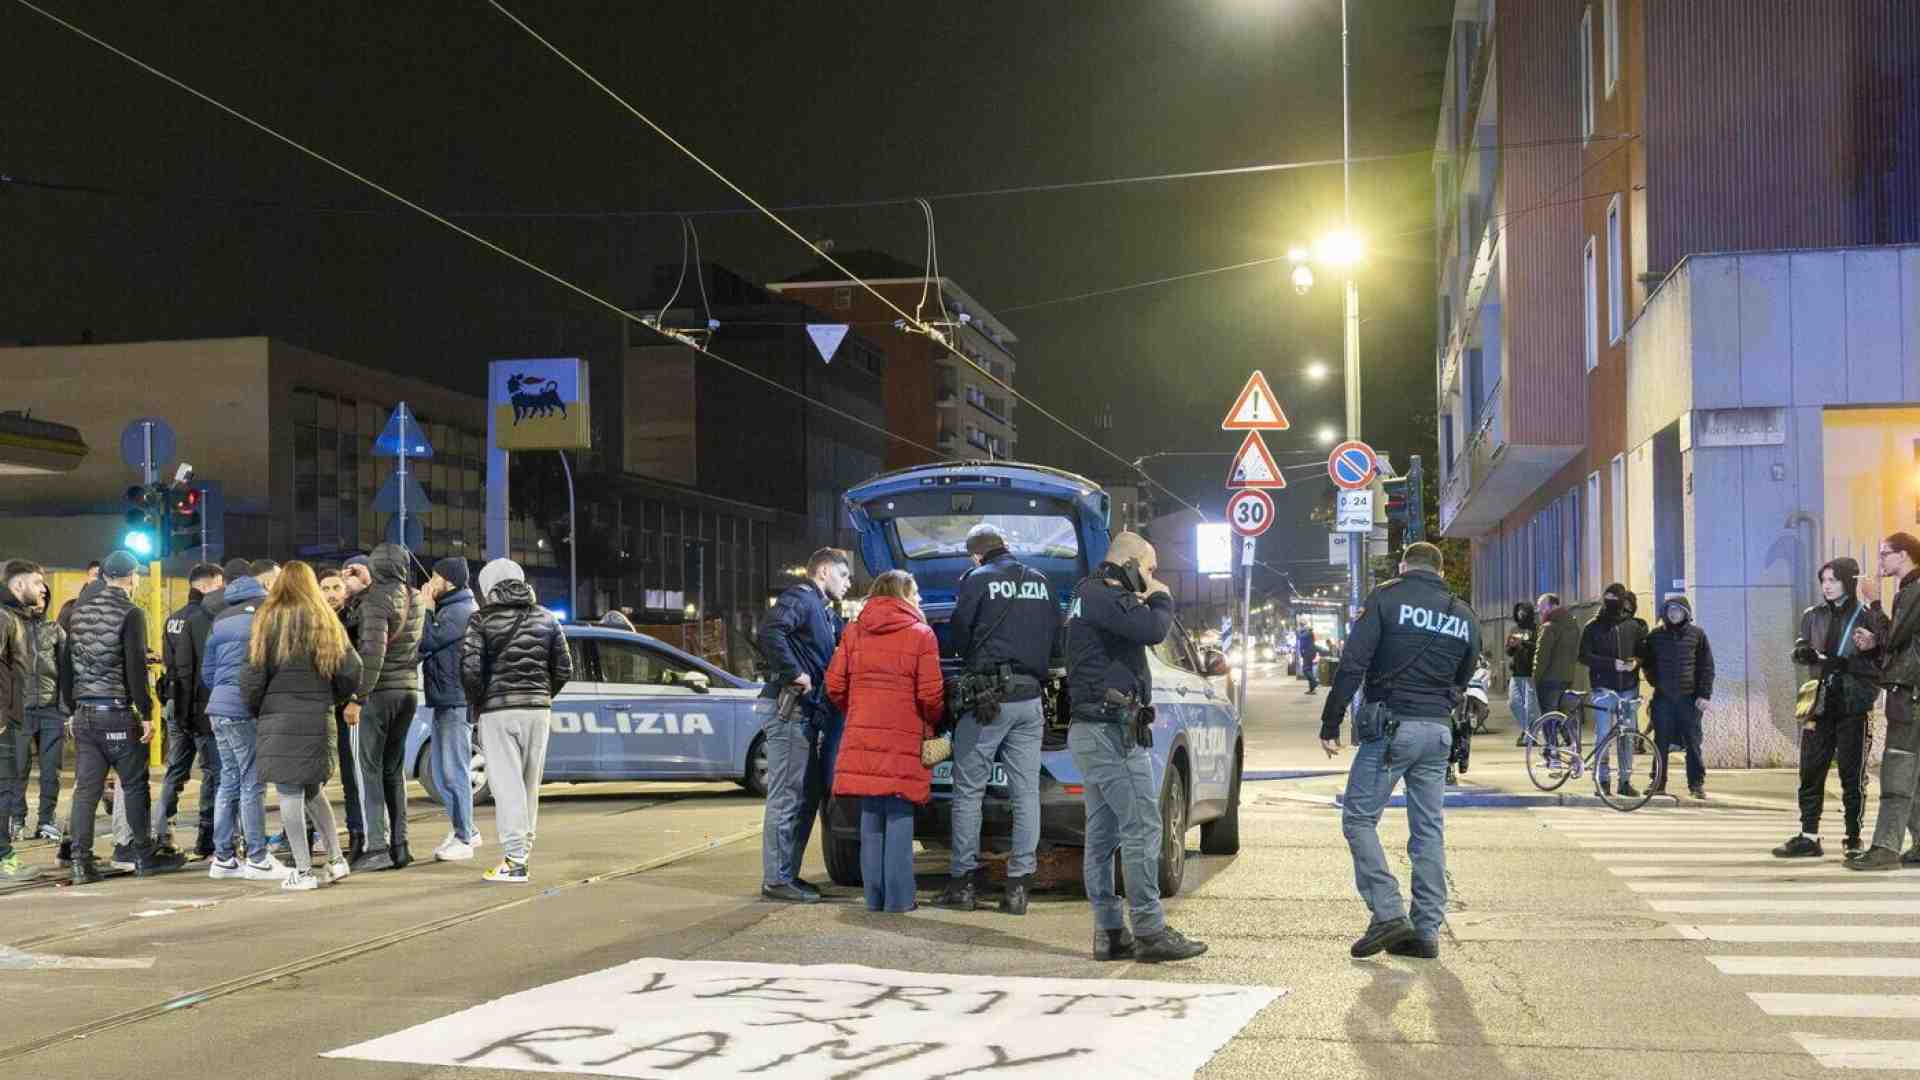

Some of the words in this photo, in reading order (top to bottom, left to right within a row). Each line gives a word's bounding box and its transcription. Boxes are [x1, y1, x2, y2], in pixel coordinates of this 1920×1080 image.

[1238, 502, 1263, 523] 30
[988, 580, 1049, 600] POLIZIA
[1398, 604, 1469, 642] POLIZIA
[551, 711, 714, 734] OLIZIA
